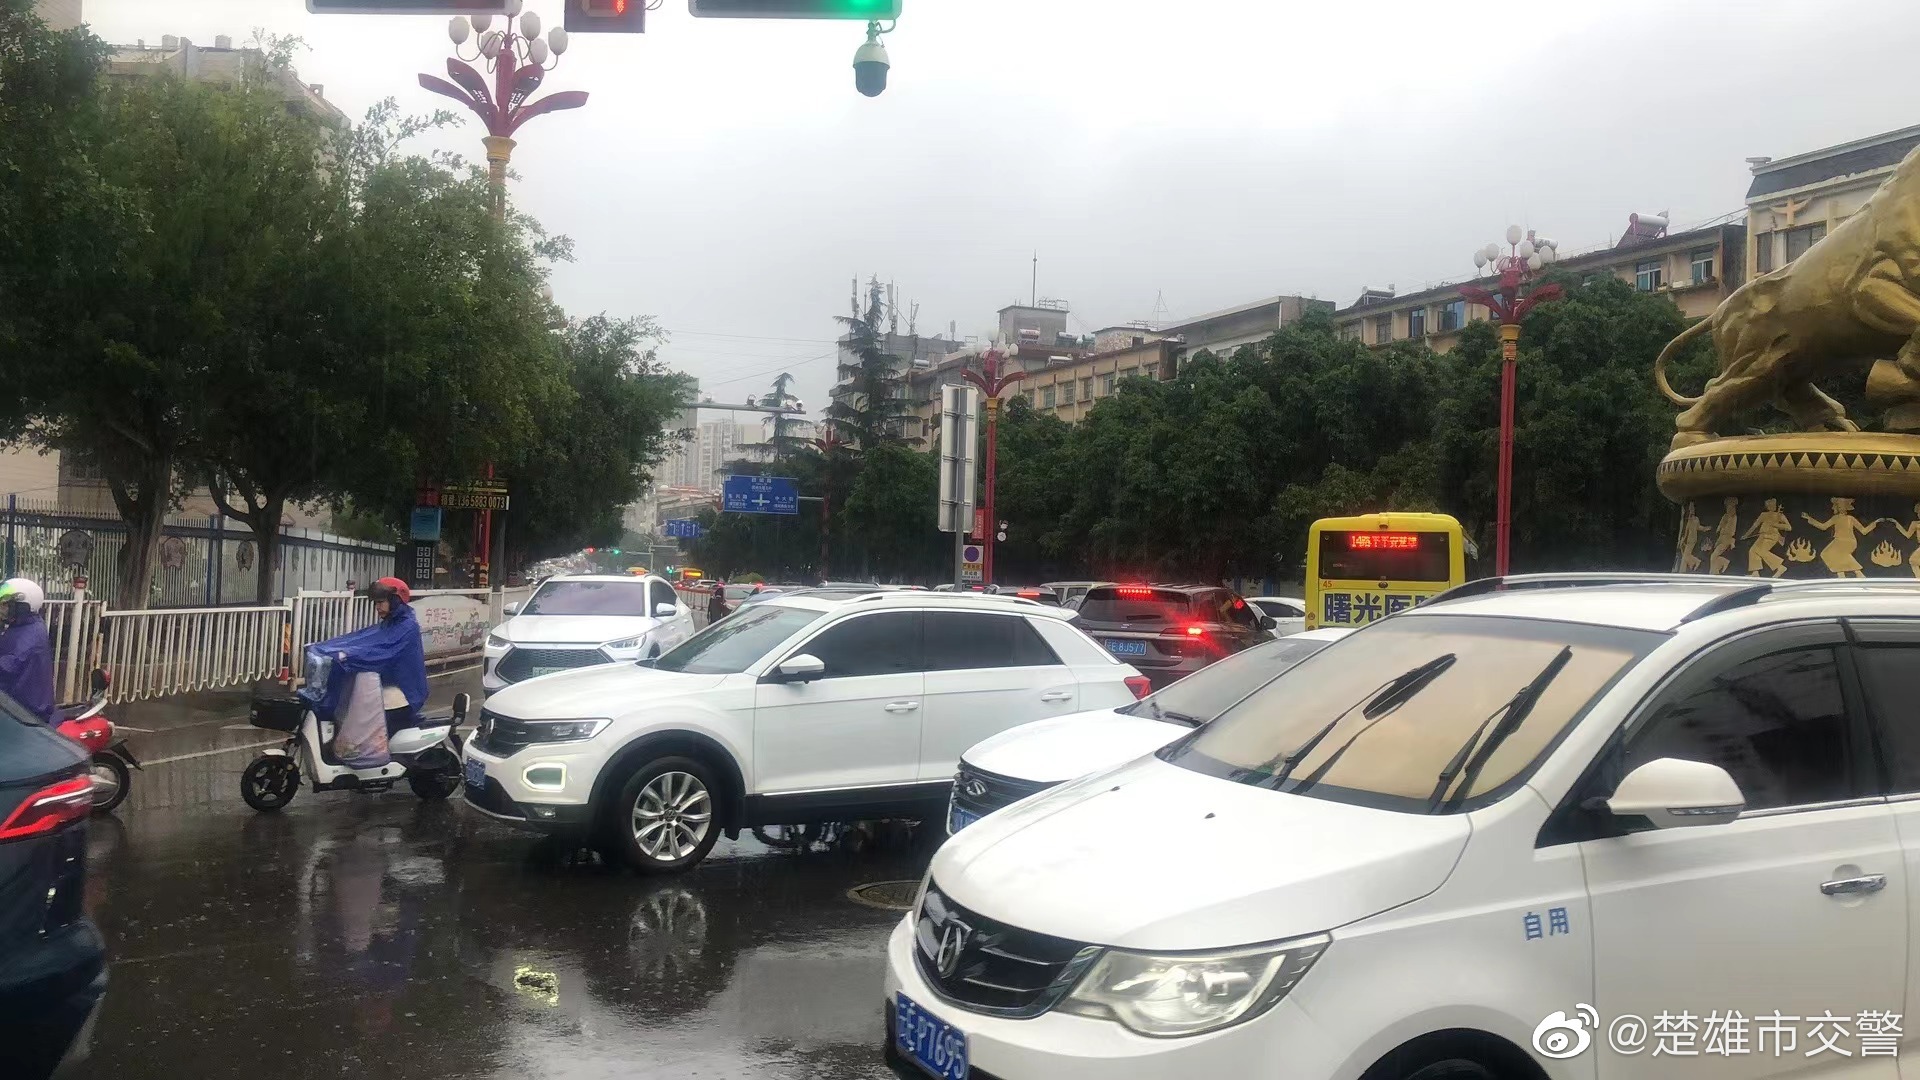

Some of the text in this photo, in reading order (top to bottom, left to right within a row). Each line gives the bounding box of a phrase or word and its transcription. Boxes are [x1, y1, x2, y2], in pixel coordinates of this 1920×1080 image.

[1324, 592, 1434, 624] 曙光医
[1523, 907, 1570, 942] 自用
